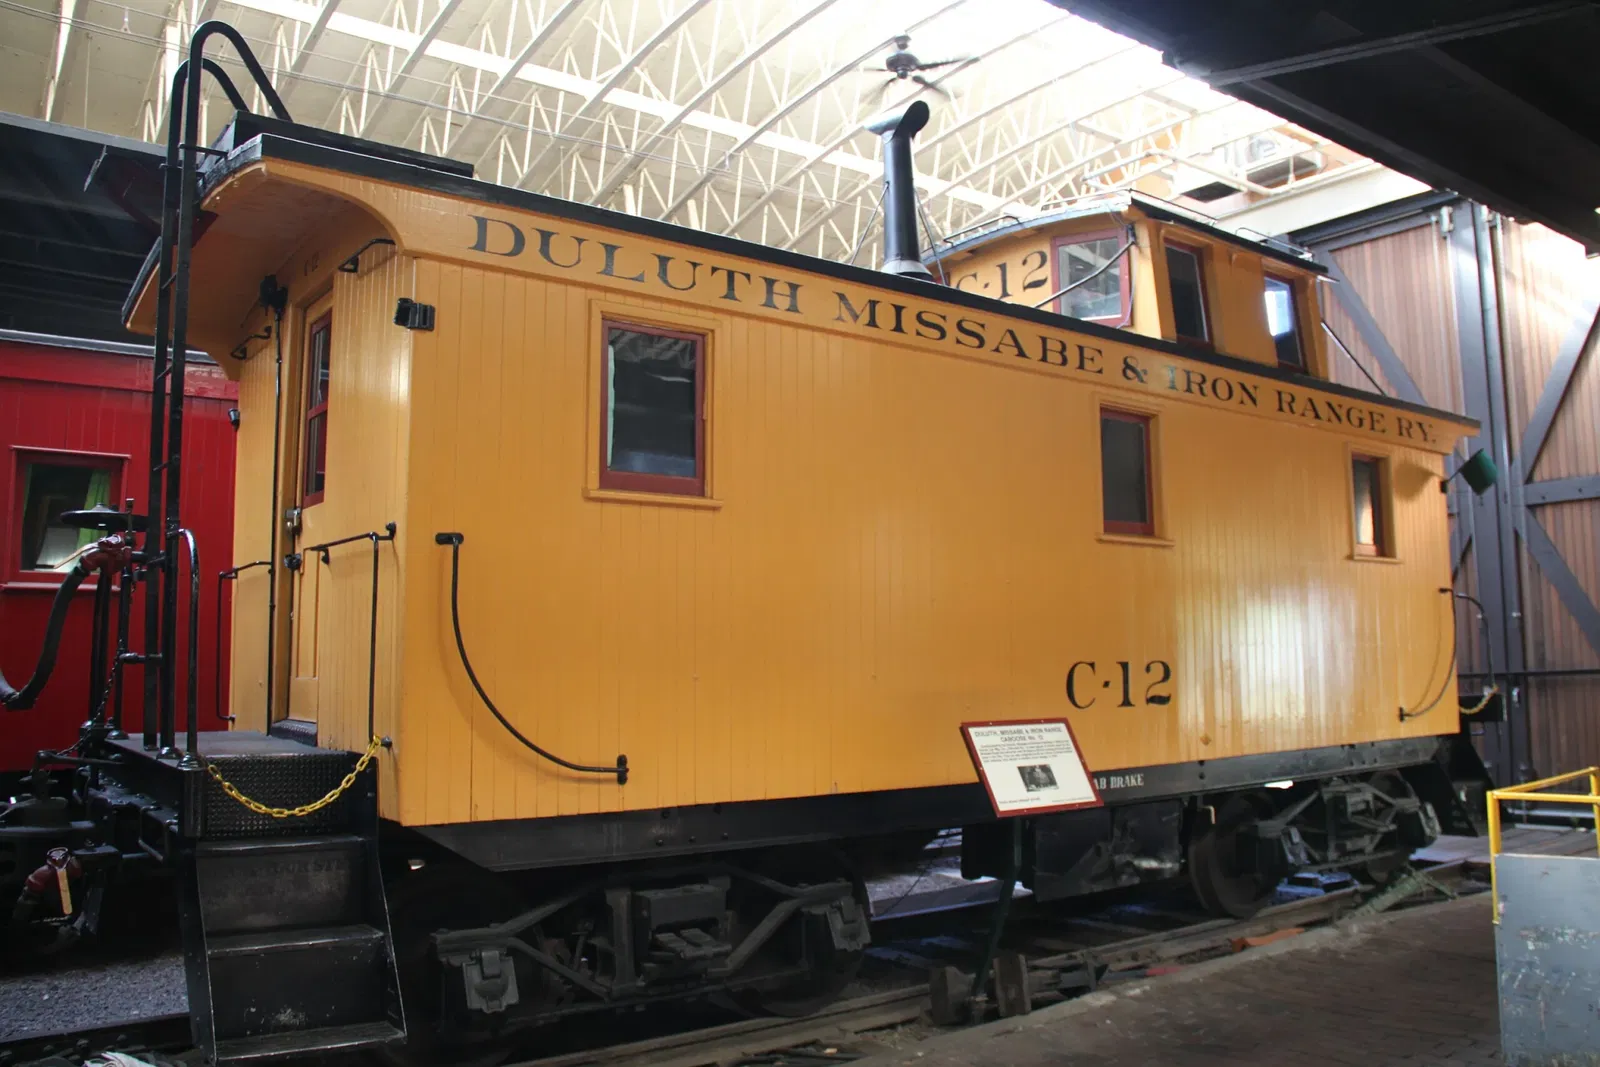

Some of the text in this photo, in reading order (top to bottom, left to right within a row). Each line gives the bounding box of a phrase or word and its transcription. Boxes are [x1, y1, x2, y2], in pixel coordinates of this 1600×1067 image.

[468, 214, 1437, 444] DULUTH MISSABE & IRON RANGE RY.
[1066, 660, 1172, 709] C-12
[1110, 773, 1145, 788] BRAKE
